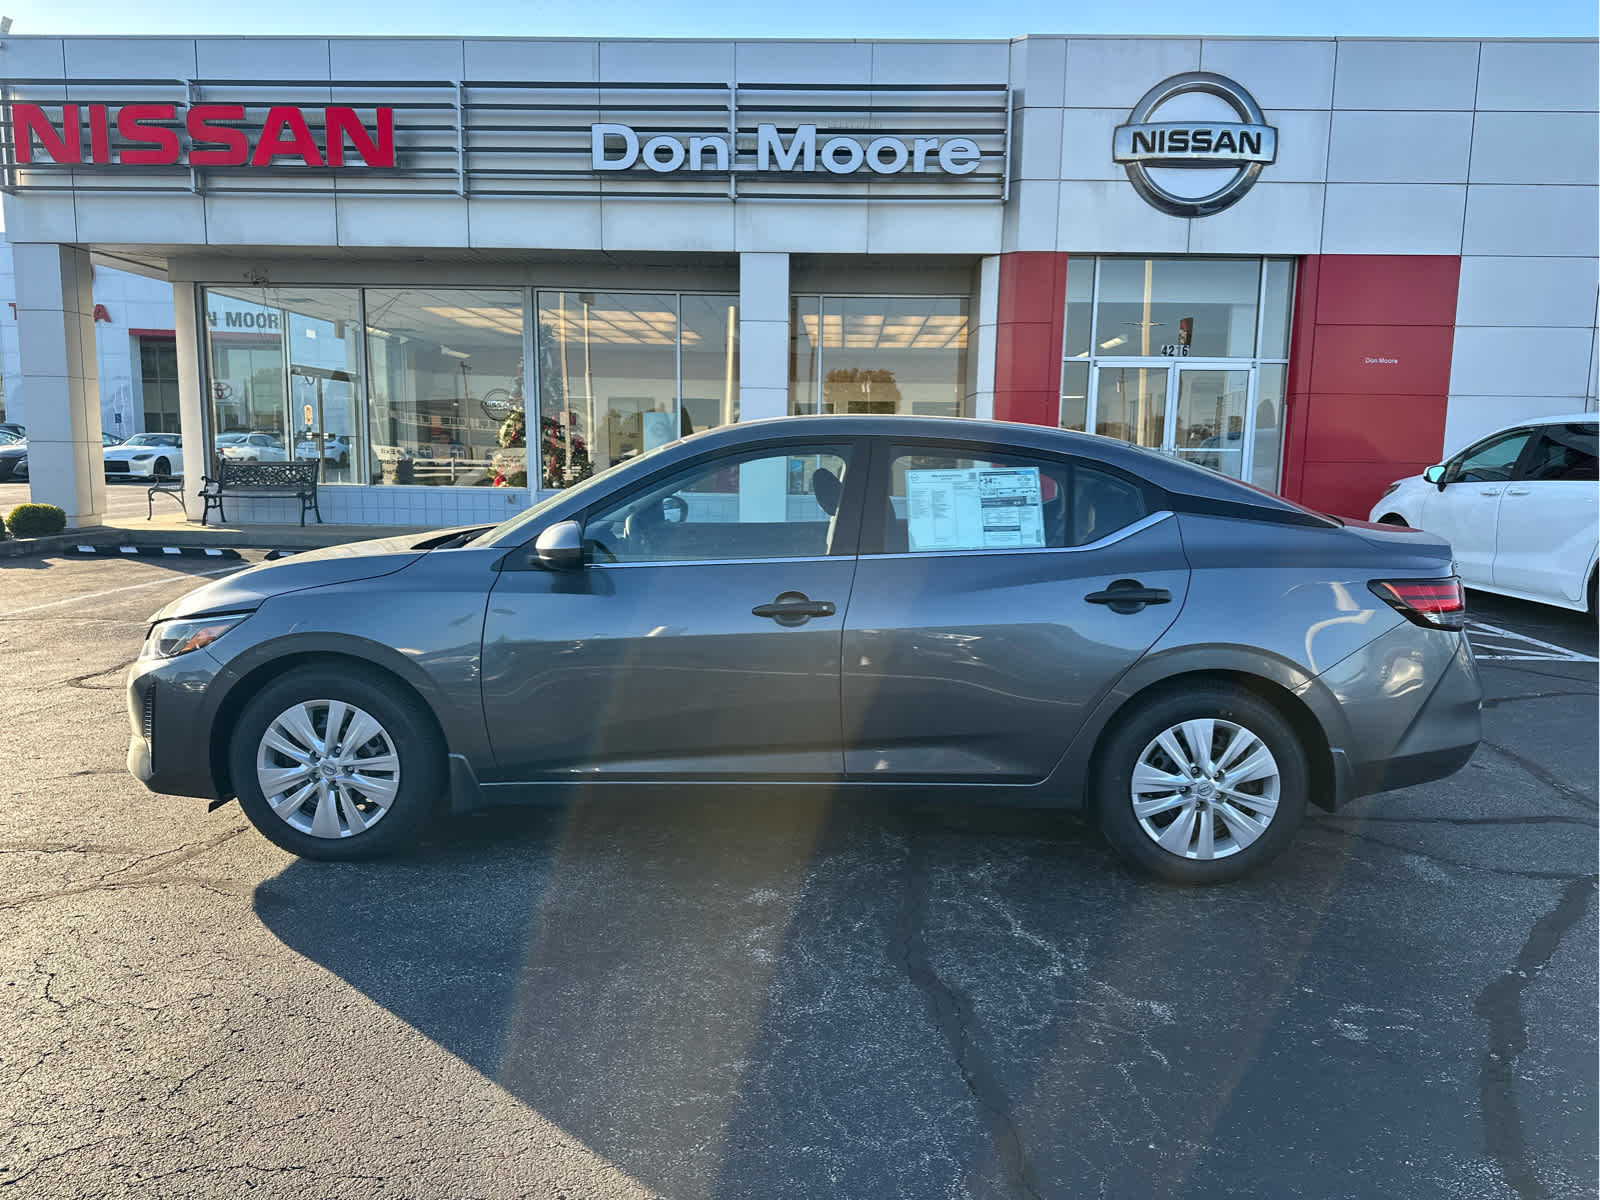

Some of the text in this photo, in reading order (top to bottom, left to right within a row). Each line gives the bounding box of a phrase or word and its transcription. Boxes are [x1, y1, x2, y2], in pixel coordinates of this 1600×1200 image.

[11, 104, 394, 168] NISSAN
[591, 123, 981, 174] Don Moore
[1131, 130, 1261, 154] NISSAN
[225, 312, 280, 328] MOOR
